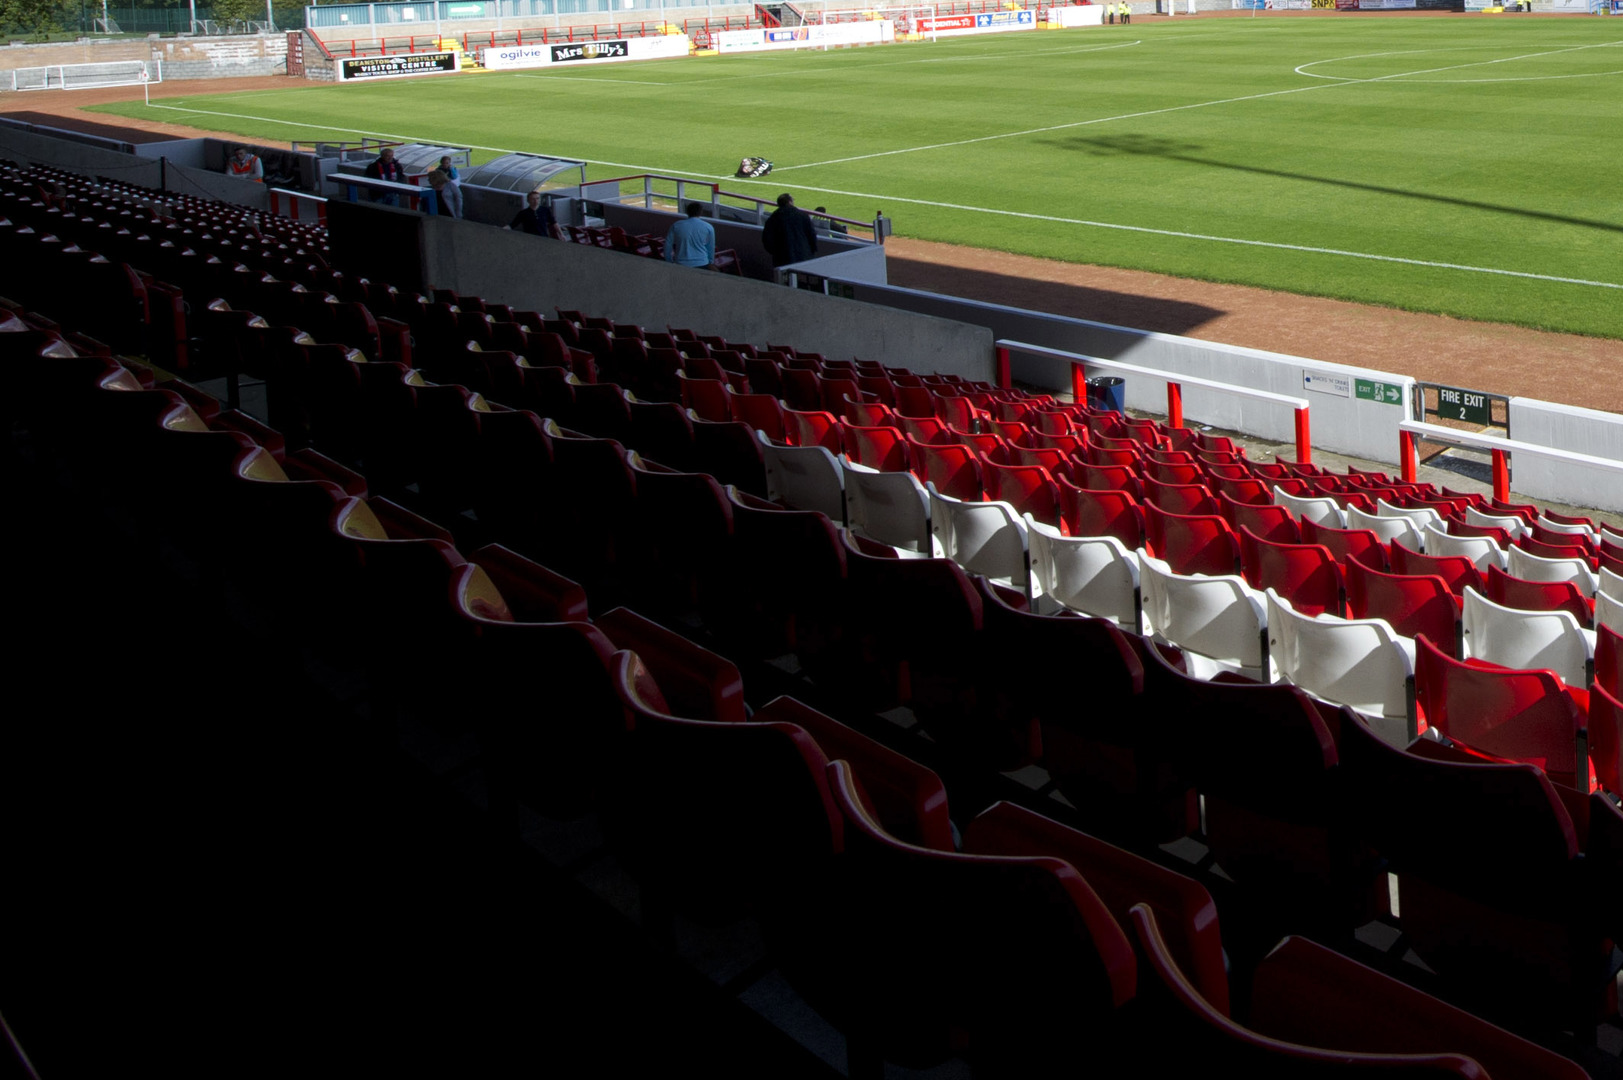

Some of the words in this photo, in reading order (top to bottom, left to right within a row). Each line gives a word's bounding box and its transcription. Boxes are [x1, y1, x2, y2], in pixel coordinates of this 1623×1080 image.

[1312, 0, 1329, 8] SNP
[500, 49, 541, 61] ogilvie
[556, 48, 583, 61] Mrs
[584, 43, 624, 57] Tilly's
[348, 58, 390, 67] DEANSTON
[408, 55, 449, 63] DISTILLERY
[361, 63, 398, 72] VISITOR
[401, 61, 437, 69] CENTRE
[1358, 385, 1371, 394] EXIT
[1440, 389, 1460, 404] FIRE
[1464, 393, 1485, 408] EXIT
[1459, 407, 1466, 419] 2
